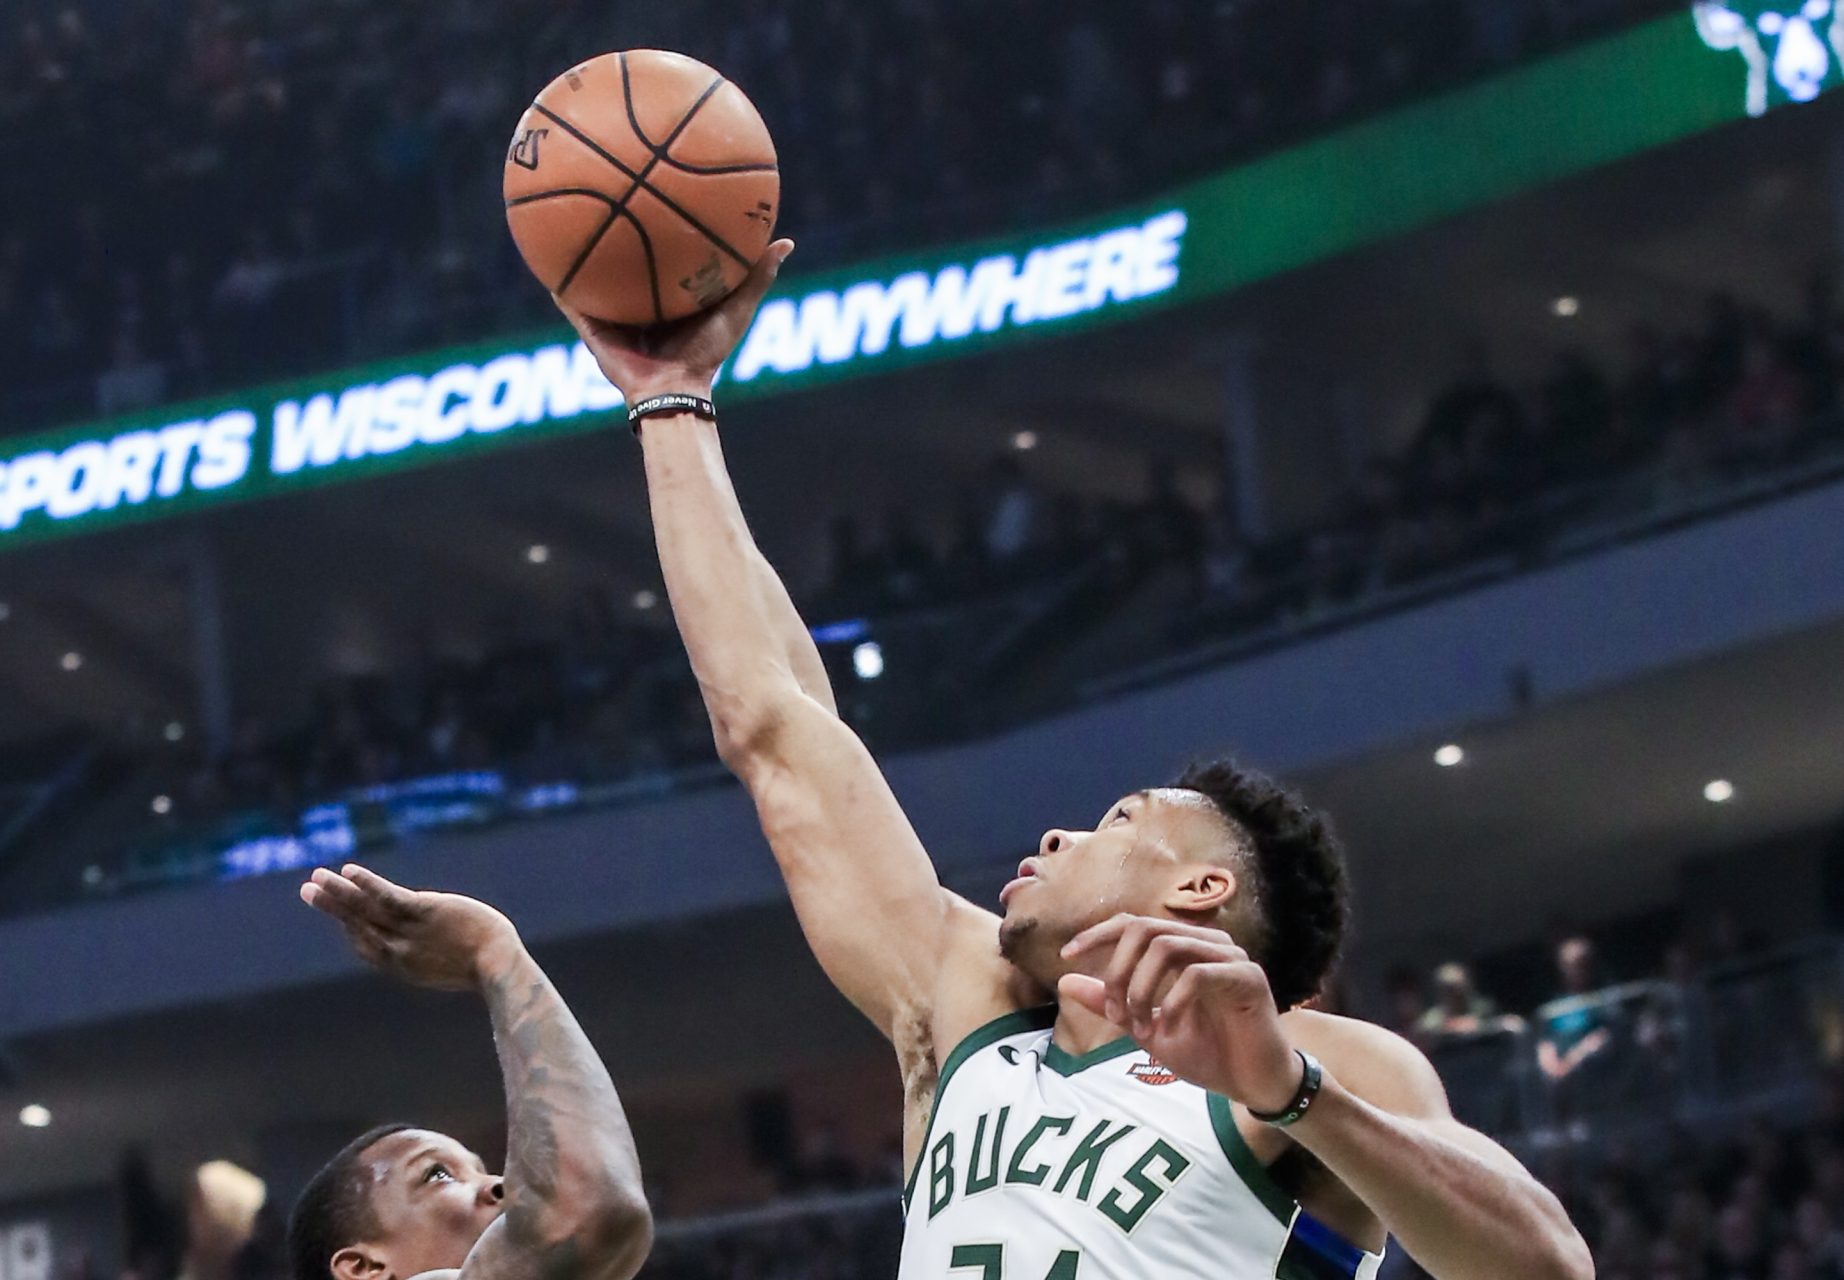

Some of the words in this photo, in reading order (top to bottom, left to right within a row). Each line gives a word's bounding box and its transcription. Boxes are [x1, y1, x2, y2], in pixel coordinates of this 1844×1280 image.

[0, 411, 256, 531] PORTS
[732, 210, 1188, 381] ANYWHERE
[637, 398, 660, 412] Give
[662, 396, 697, 408] Never
[928, 1105, 1191, 1234] BUCKS
